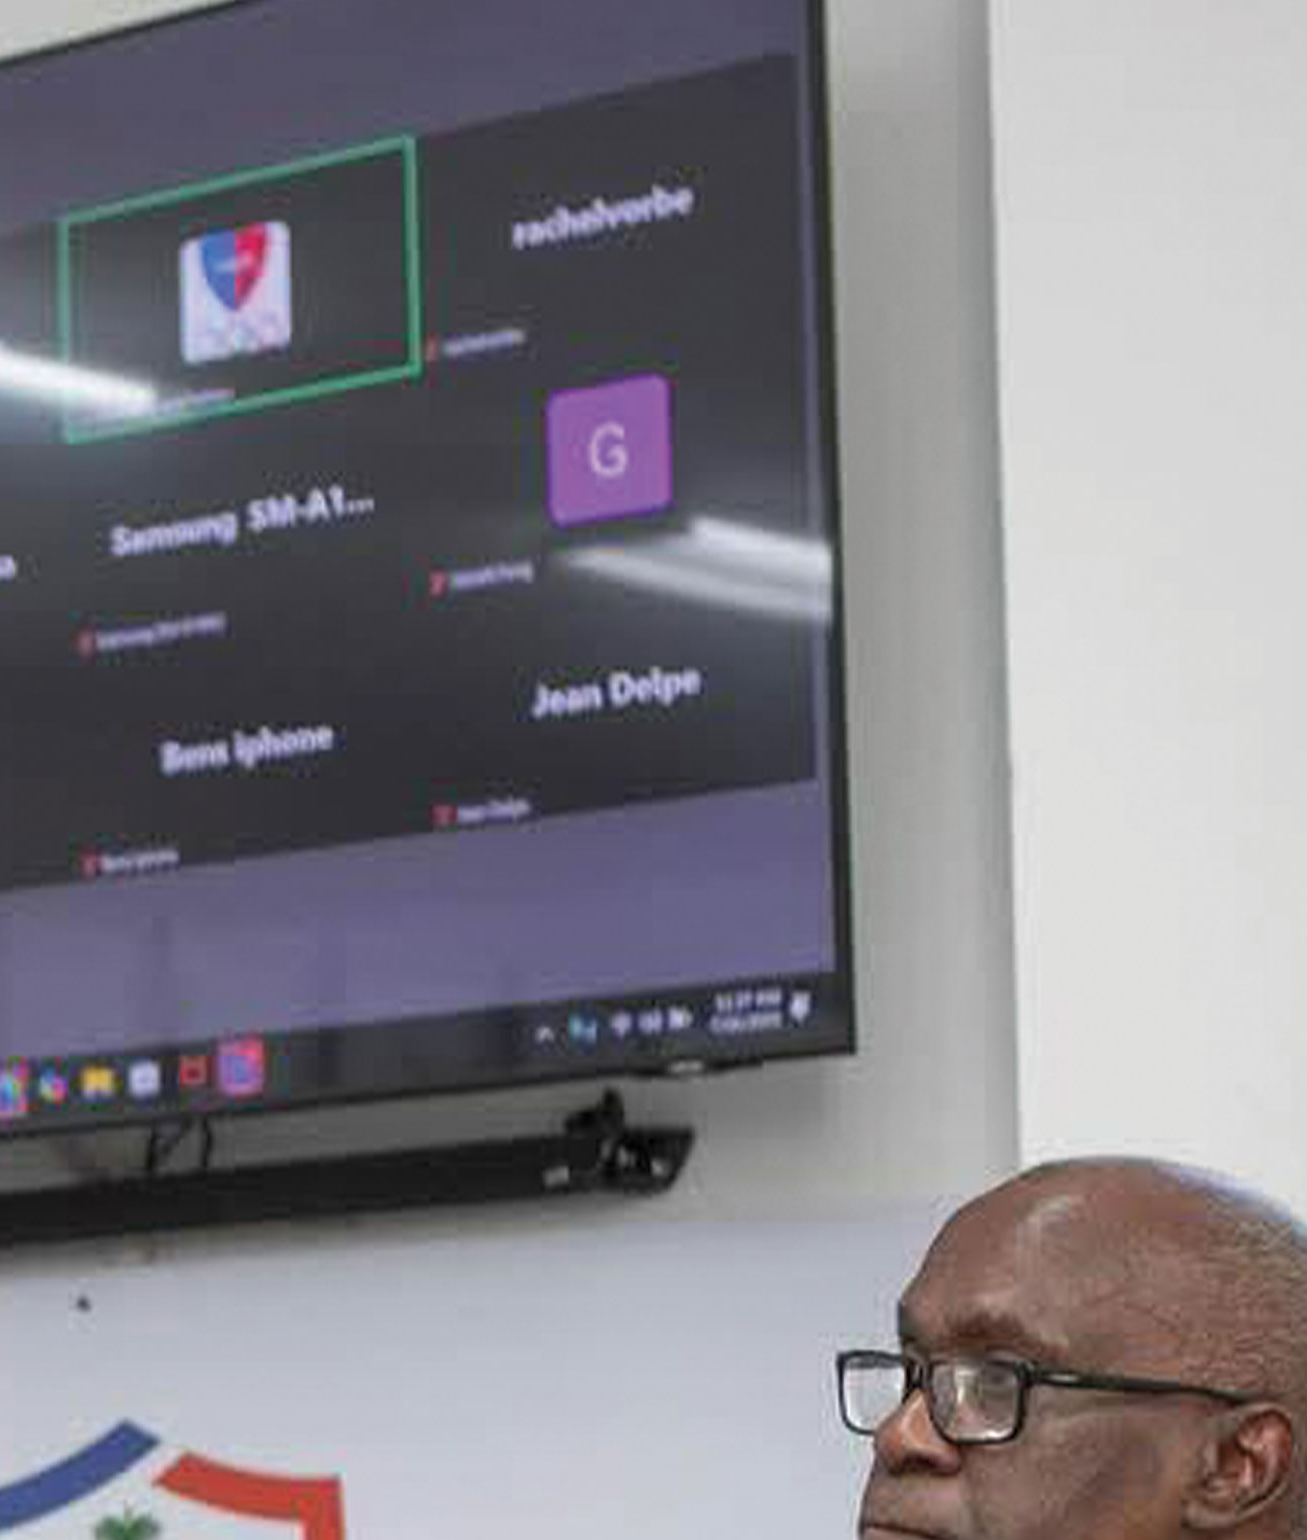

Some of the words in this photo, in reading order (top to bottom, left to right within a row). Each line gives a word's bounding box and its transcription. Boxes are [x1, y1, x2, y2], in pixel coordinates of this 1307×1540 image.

[588, 420, 629, 478] G
[109, 511, 238, 557] Samsung
[532, 682, 604, 720] Jean
